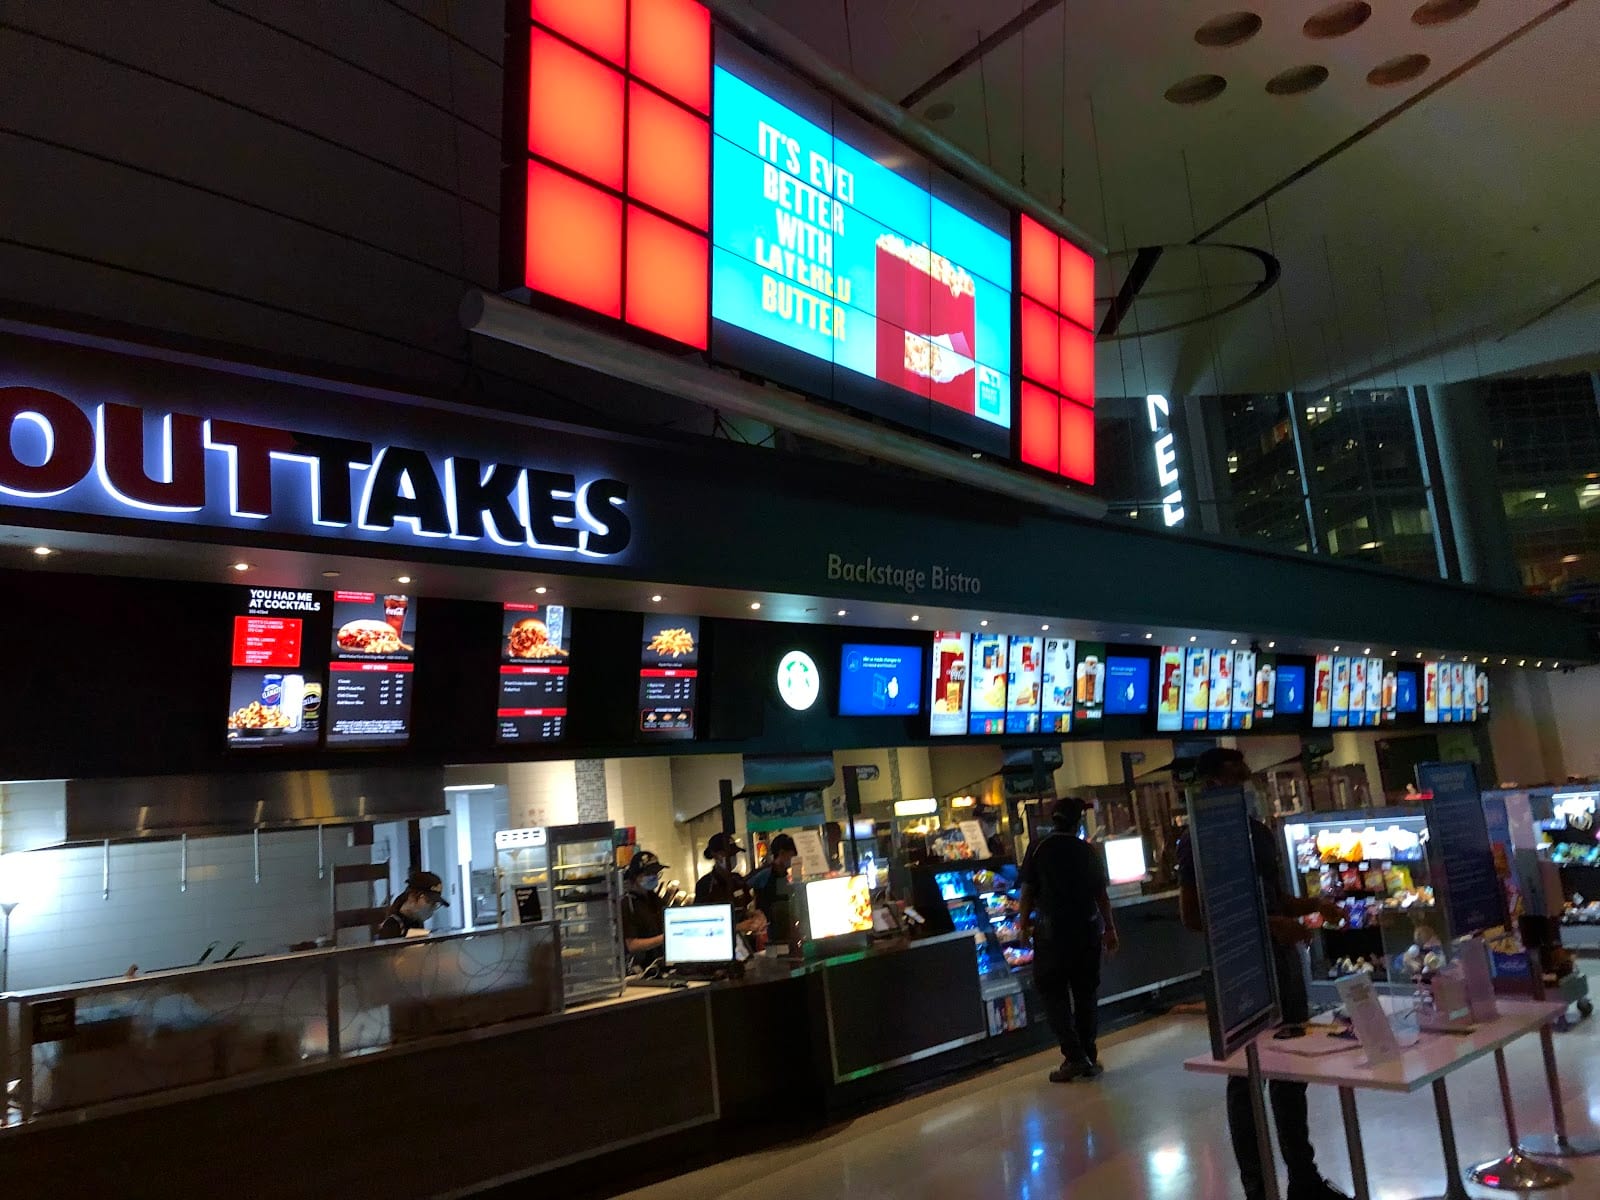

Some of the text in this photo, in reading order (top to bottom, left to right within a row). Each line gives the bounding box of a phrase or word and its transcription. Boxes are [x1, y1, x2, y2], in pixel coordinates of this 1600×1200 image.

[758, 120, 801, 175] IT'S
[763, 162, 845, 237] BETTER
[775, 207, 833, 268] WITH
[762, 274, 846, 341] BUTTER
[0, 386, 633, 557] OUTTAKES
[249, 589, 313, 602] YOU HAD ME
[827, 553, 982, 595] Backstage Bistro
[249, 599, 321, 611] AT COCKTAILS
